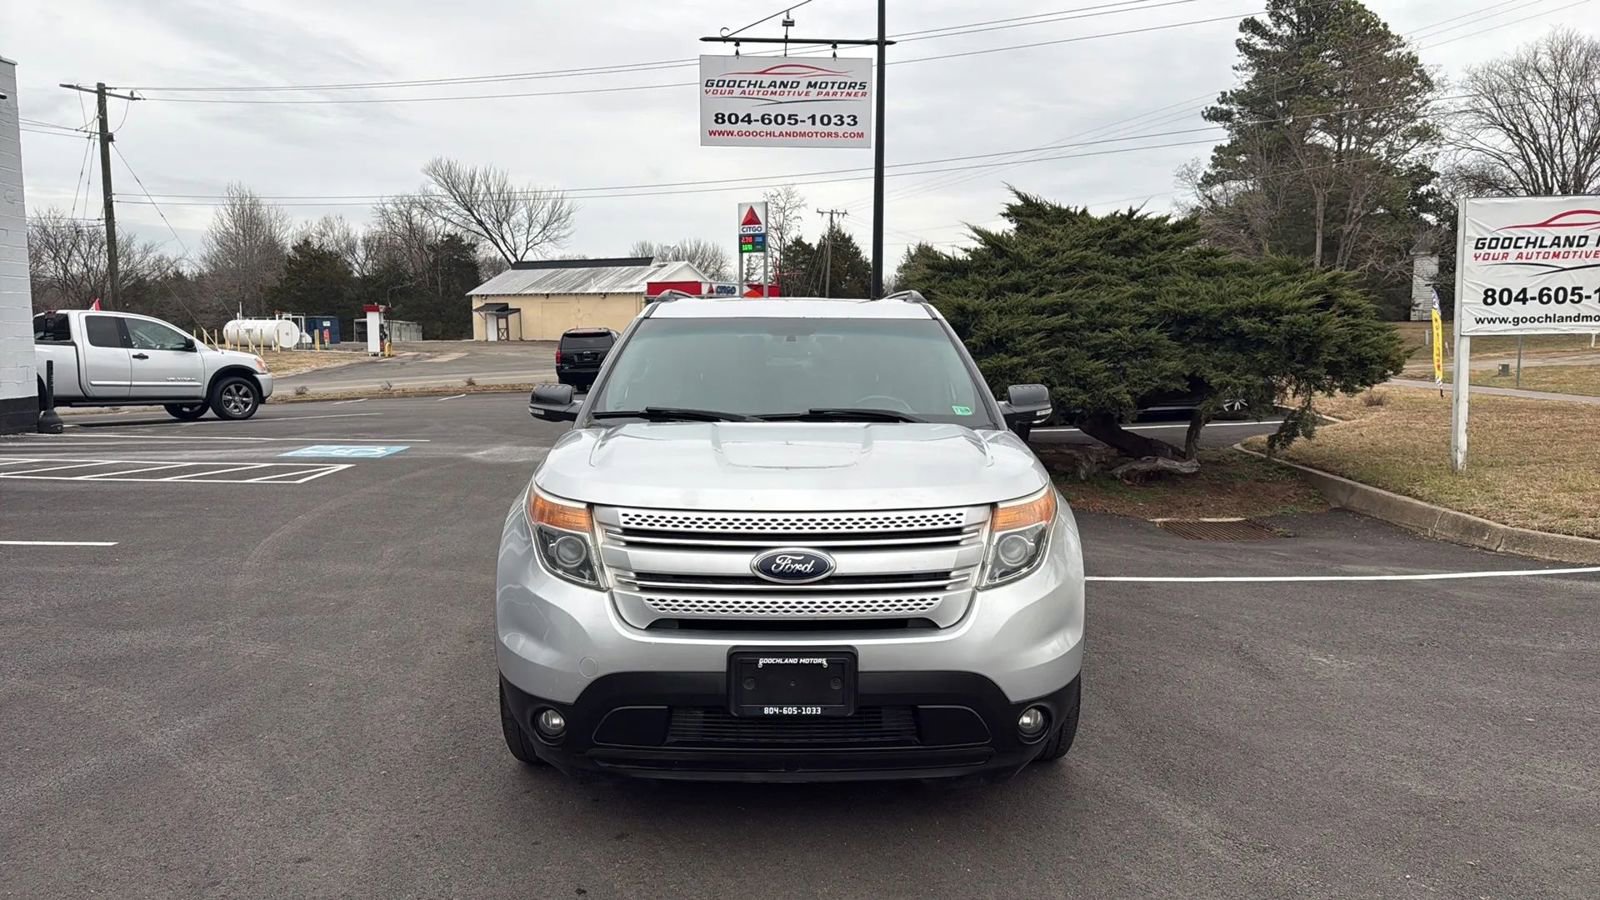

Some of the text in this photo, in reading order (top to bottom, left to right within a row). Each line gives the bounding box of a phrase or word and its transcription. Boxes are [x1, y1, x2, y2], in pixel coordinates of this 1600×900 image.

[705, 79, 867, 90] GOOCHLAND MOTORS
[740, 89, 811, 97] AUTOMOTIVE
[714, 112, 858, 126] 804-605-1033
[708, 129, 864, 139] WWW.GOOCHLANDMOTORS.COM
[1474, 235, 1589, 250] GOOCHLAND
[1473, 250, 1600, 261] YOUR AUTOMOTIVE
[716, 285, 736, 295] CITGO
[771, 554, 815, 574] Ford
[763, 706, 821, 715] 804-605-1033
